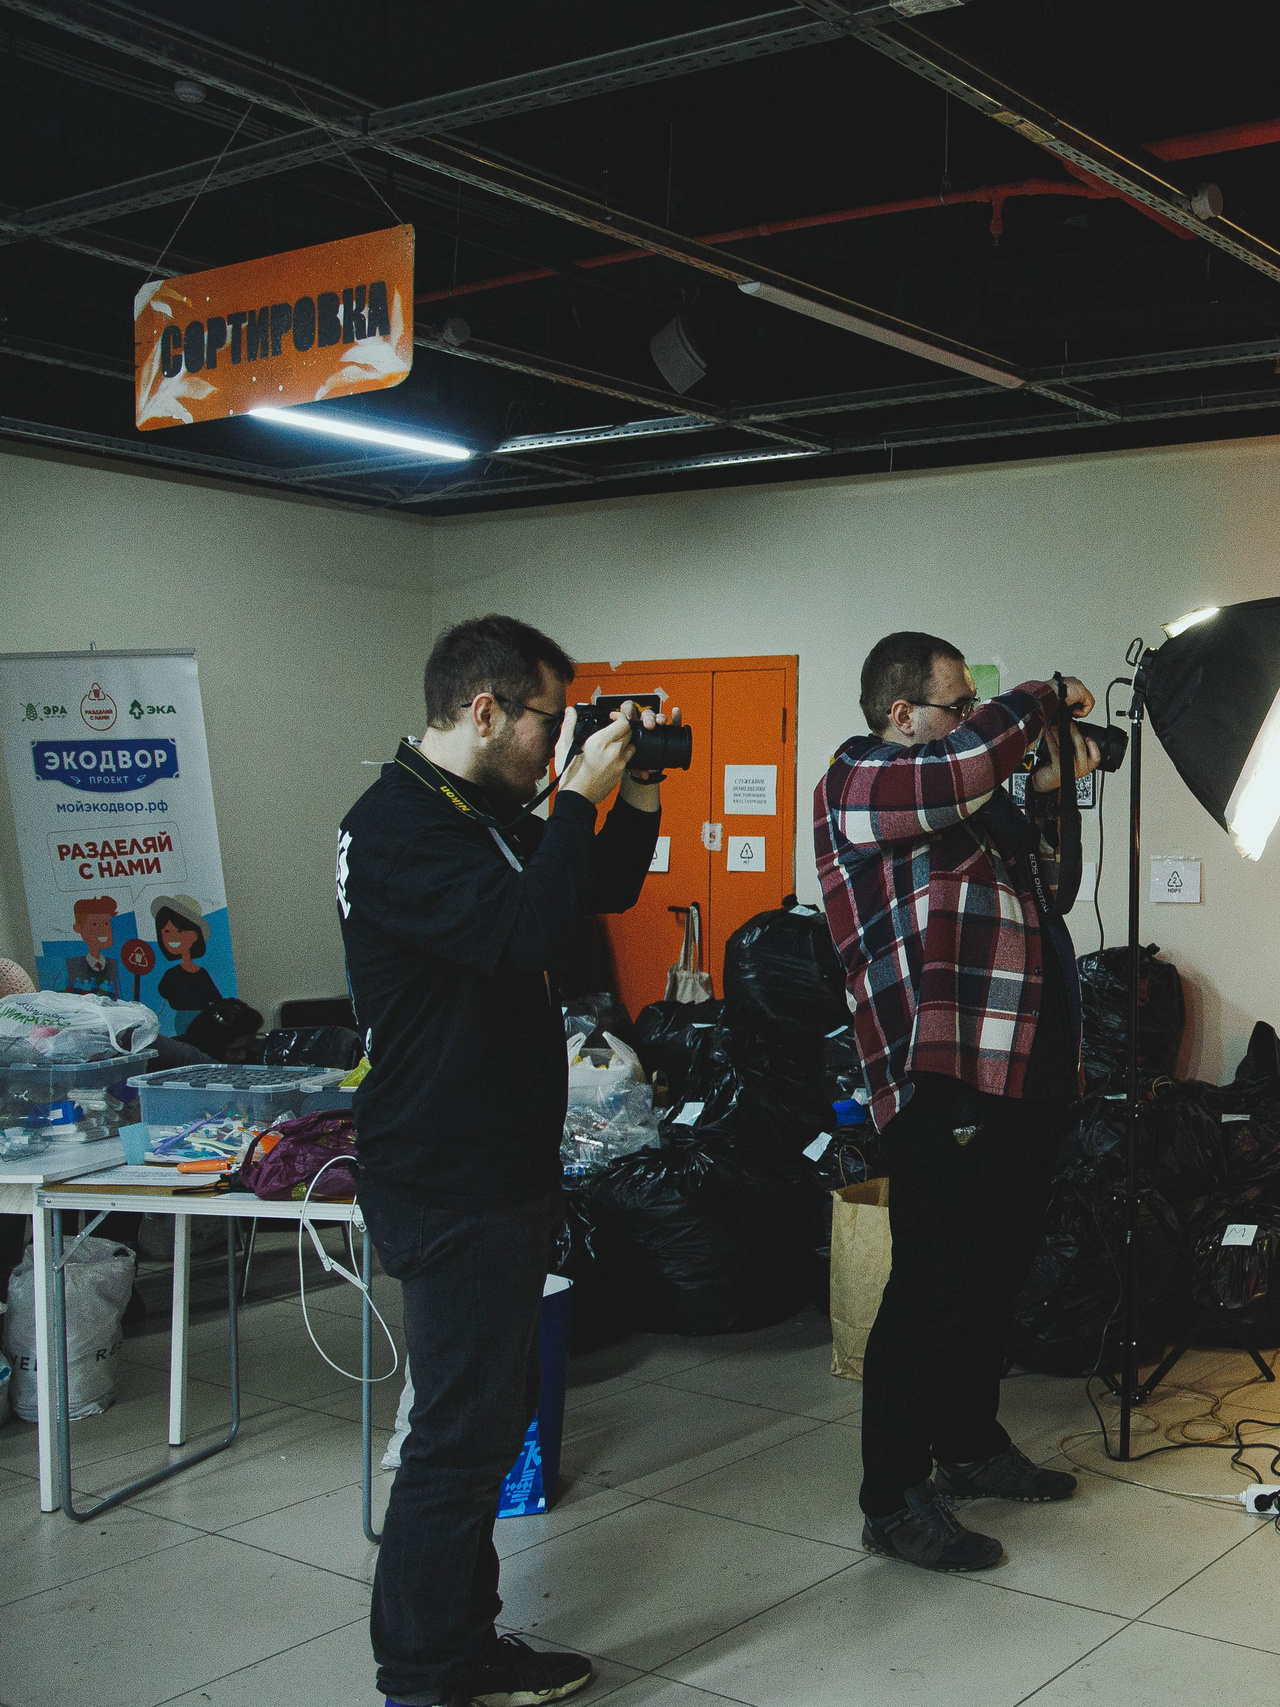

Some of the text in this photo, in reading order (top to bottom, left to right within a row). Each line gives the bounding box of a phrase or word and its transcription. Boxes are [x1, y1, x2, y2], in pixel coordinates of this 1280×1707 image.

[160, 280, 391, 378] СОРТИРОВКА
[43, 705, 68, 715] ЭРА
[146, 705, 177, 714] ЭКА
[43, 749, 168, 773] ЭКОДВОР
[89, 775, 129, 784] ПРОЕКТ
[56, 800, 169, 813] мойэкодвор.рф
[440, 785, 471, 811] Nikon
[56, 831, 173, 861] РАЗДЕЛЯЙ
[78, 857, 162, 880] С НАМИ
[1029, 853, 1040, 875] EOS
